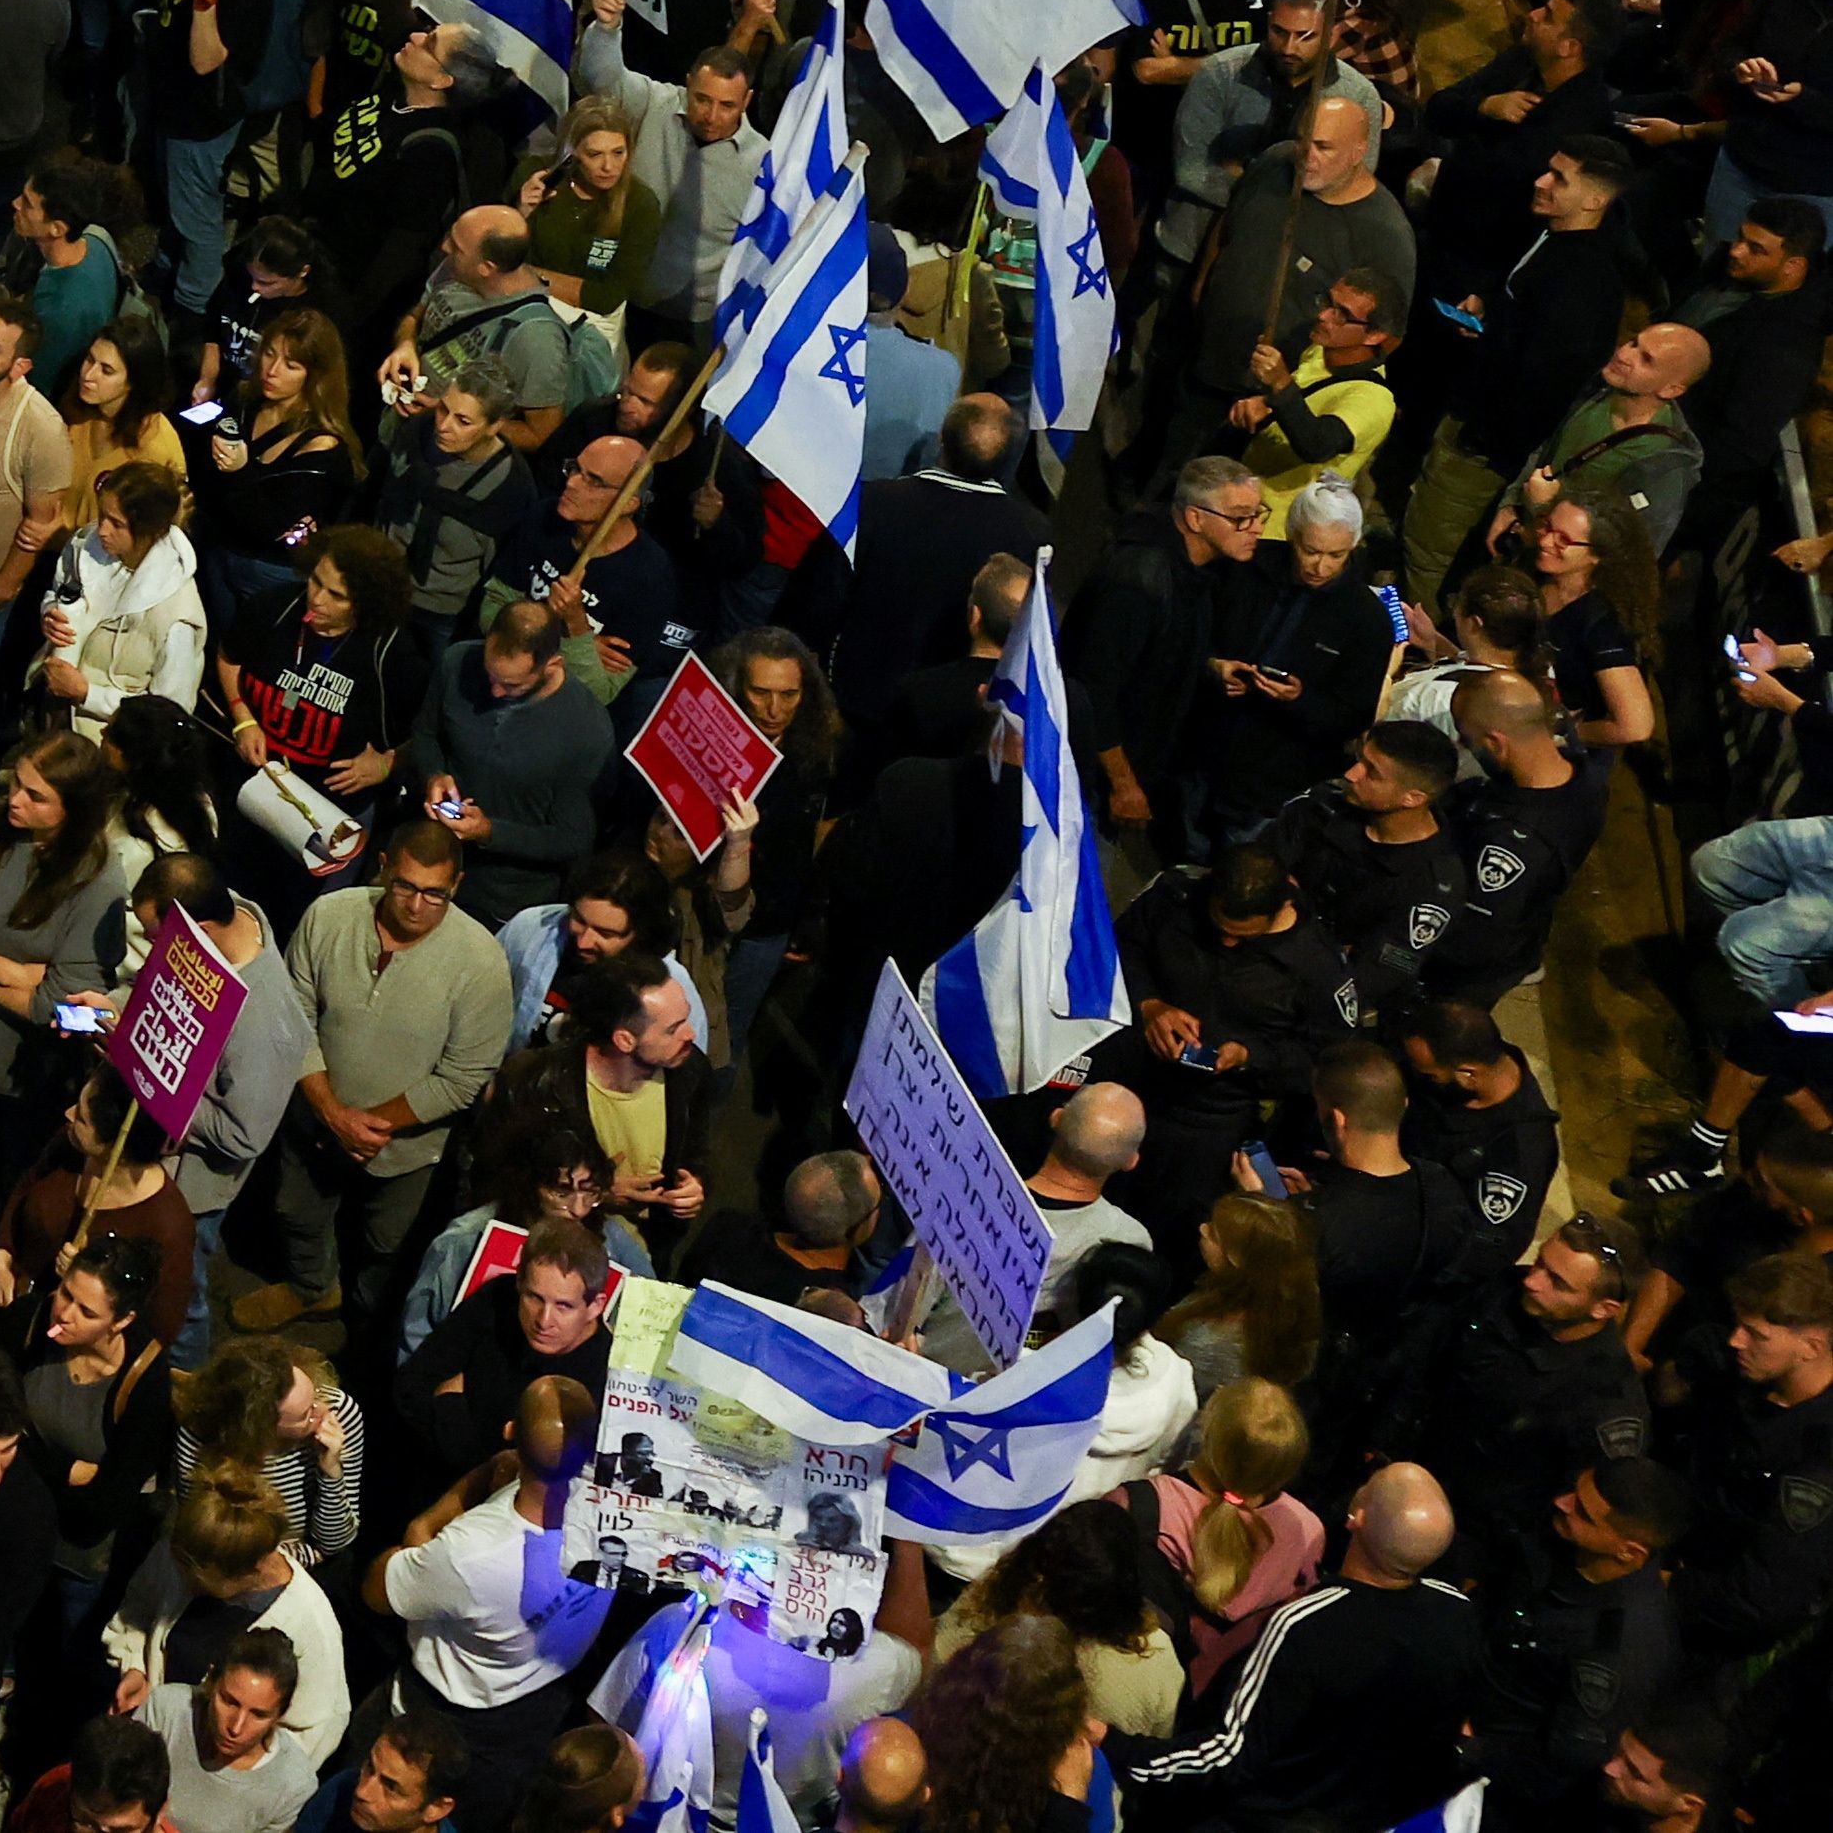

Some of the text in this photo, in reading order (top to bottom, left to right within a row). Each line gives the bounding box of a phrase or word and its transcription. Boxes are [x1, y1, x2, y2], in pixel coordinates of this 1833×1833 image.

[164, 947, 218, 1011] הסכמים
[151, 974, 204, 1045] מצילים
[129, 1019, 185, 1096] חיים
[884, 1042, 1032, 1293] אין אחריות יצרן
[856, 1106, 1012, 1367] אחראית לאובדן
[885, 1101, 1024, 1345] ההנהלה אינה
[607, 1392, 693, 1423] על הפנים
[666, 1389, 698, 1407] השר
[804, 1444, 870, 1475] חרא
[804, 1467, 868, 1493] נתניהו
[585, 1484, 652, 1509] יחריב
[596, 1510, 634, 1532] לוין
